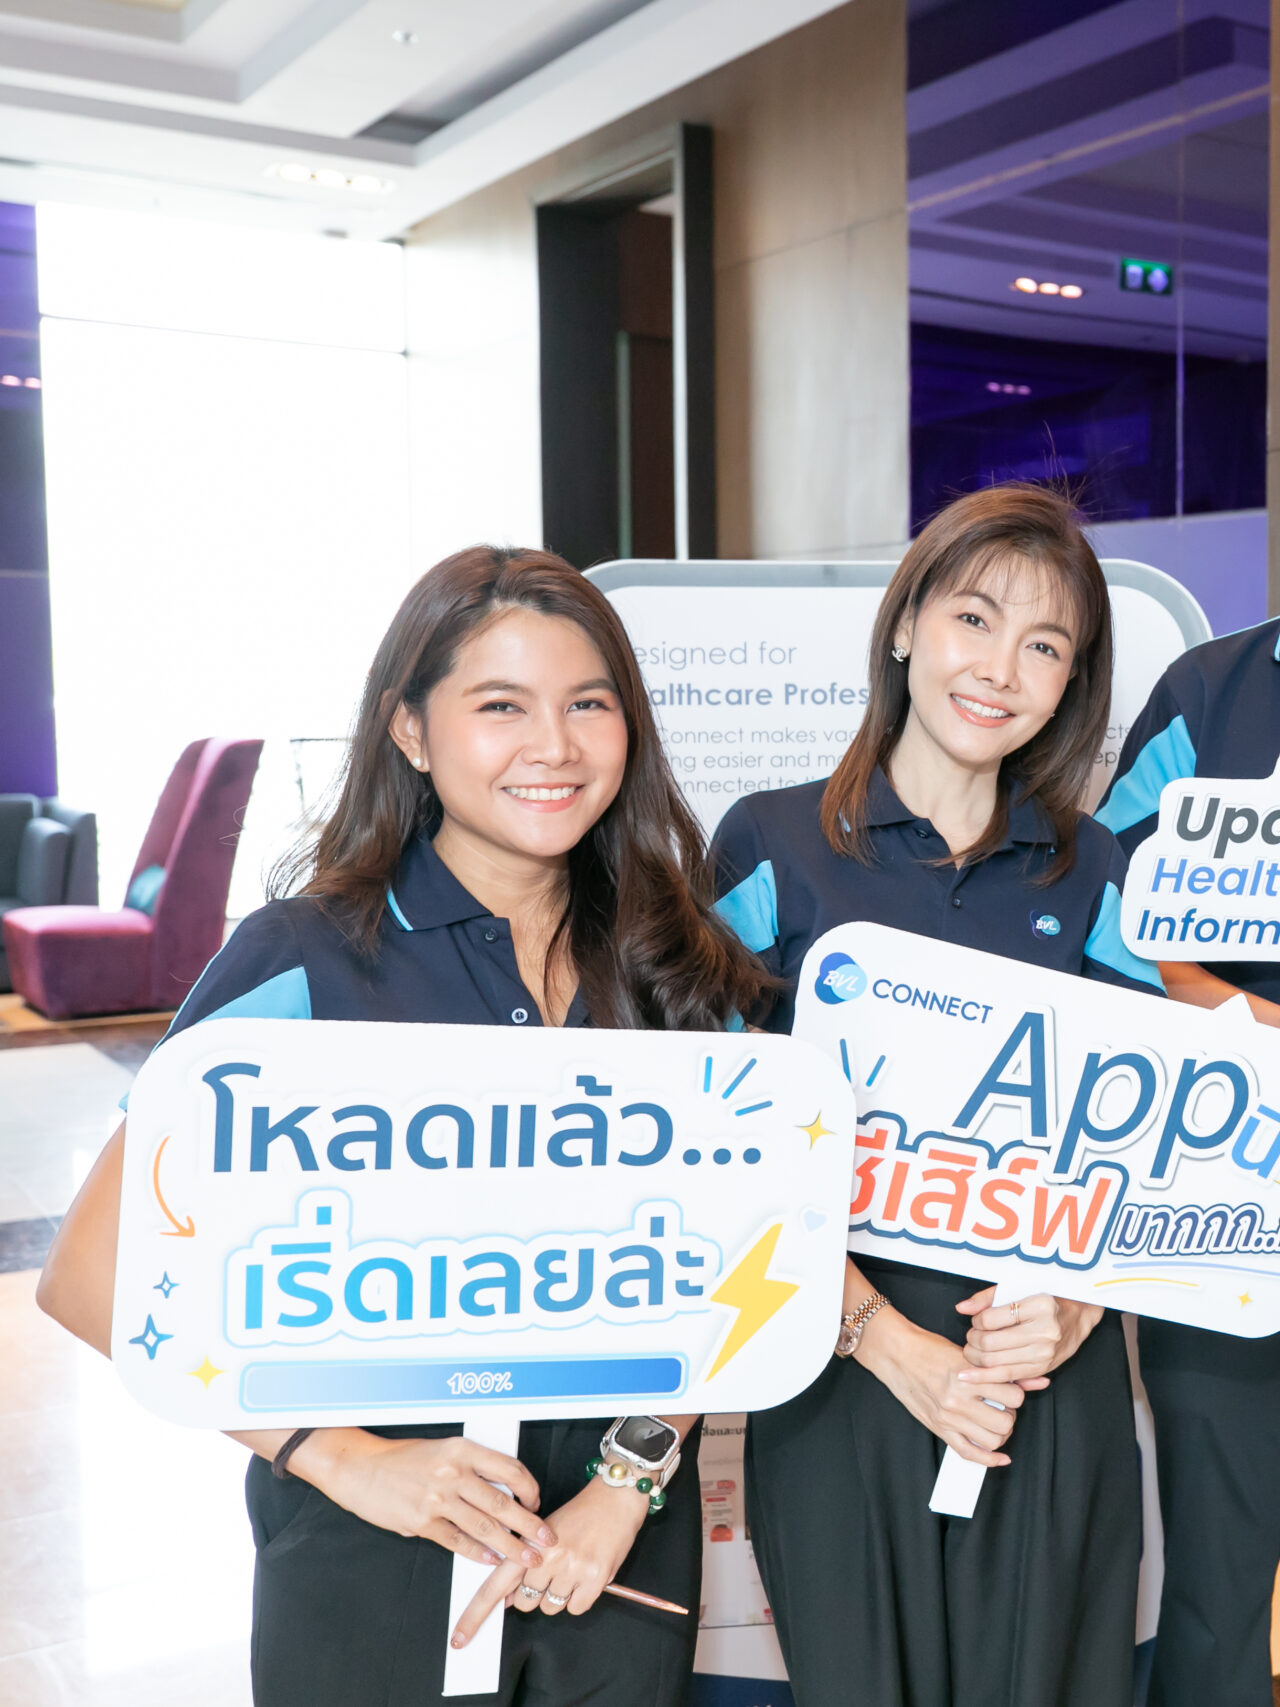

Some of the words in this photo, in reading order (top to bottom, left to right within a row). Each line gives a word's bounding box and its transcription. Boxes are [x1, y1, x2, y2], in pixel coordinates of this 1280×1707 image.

[634, 640, 748, 671] esigned
[760, 640, 798, 665] for
[651, 683, 774, 706] althcare
[784, 682, 869, 706] Profes
[750, 727, 817, 744] makes
[703, 753, 762, 769] easier
[769, 751, 811, 768] and
[682, 775, 770, 793] nnected
[1035, 919, 1057, 931] BVL
[822, 969, 860, 993] BVL
[872, 978, 994, 1025] CONNECT
[951, 1010, 1251, 1179] App
[201, 1061, 763, 1174] โหลดแล้ว...
[244, 1205, 705, 1330] เริ่ดเลยล่ะ
[446, 1371, 514, 1396] 100%
